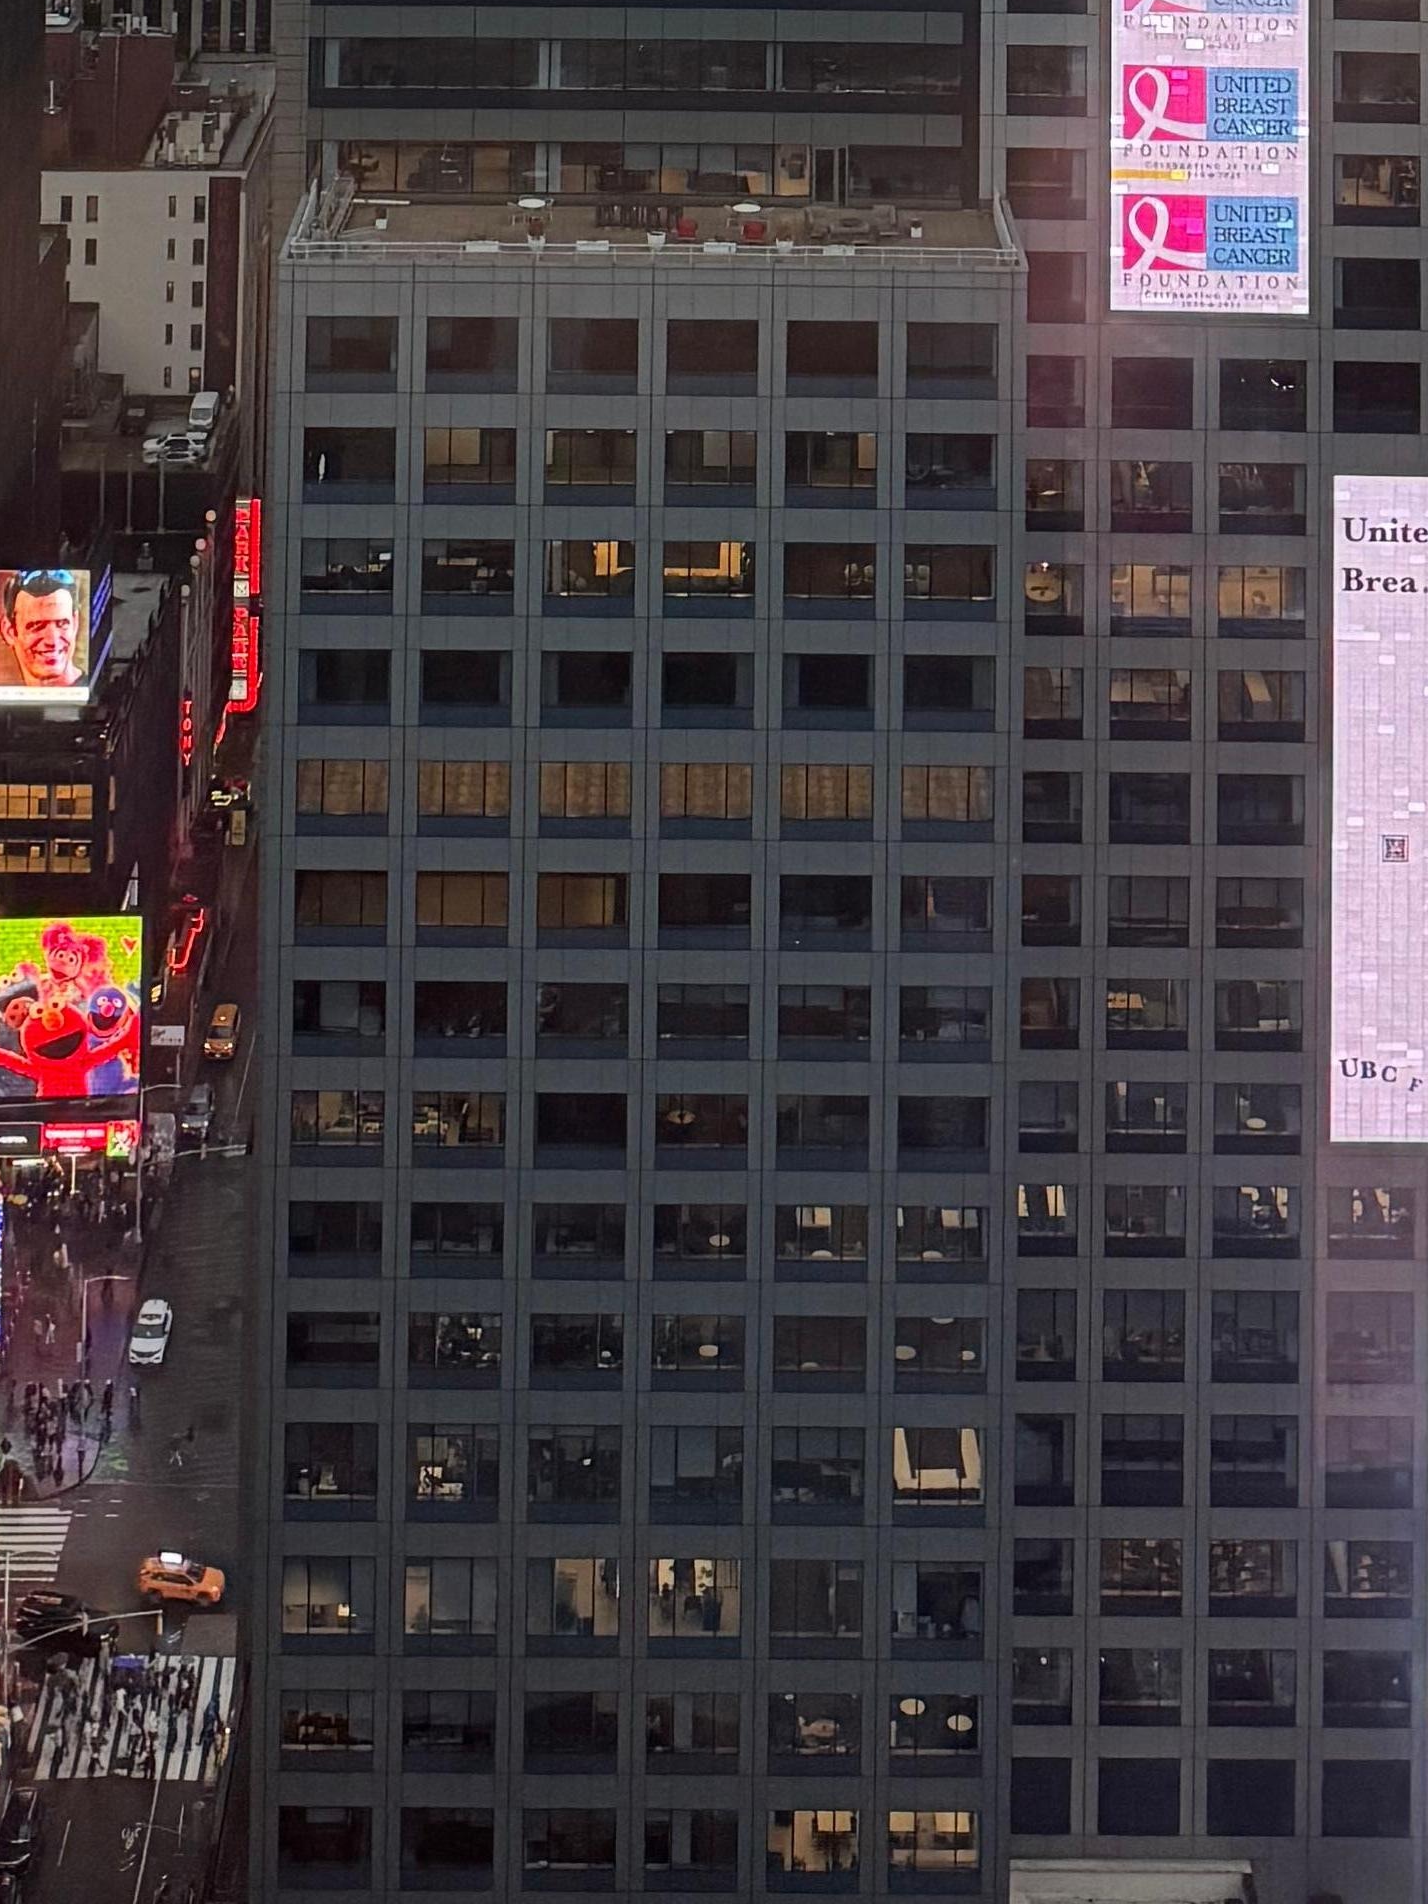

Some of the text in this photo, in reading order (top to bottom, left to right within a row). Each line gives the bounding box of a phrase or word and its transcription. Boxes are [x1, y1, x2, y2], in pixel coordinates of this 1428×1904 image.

[1214, 75, 1292, 94] UNITED
[1214, 97, 1291, 115] BREAST
[1213, 118, 1291, 136] CANCER
[1123, 143, 1299, 160] FOUNDATION
[1214, 204, 1292, 223] UNITED
[1214, 226, 1288, 244] BREAST
[1213, 248, 1291, 265] CANCER
[1123, 273, 1299, 290] FOUNDATION
[234, 507, 251, 573] PARK
[1338, 1057, 1398, 1083] UBC
